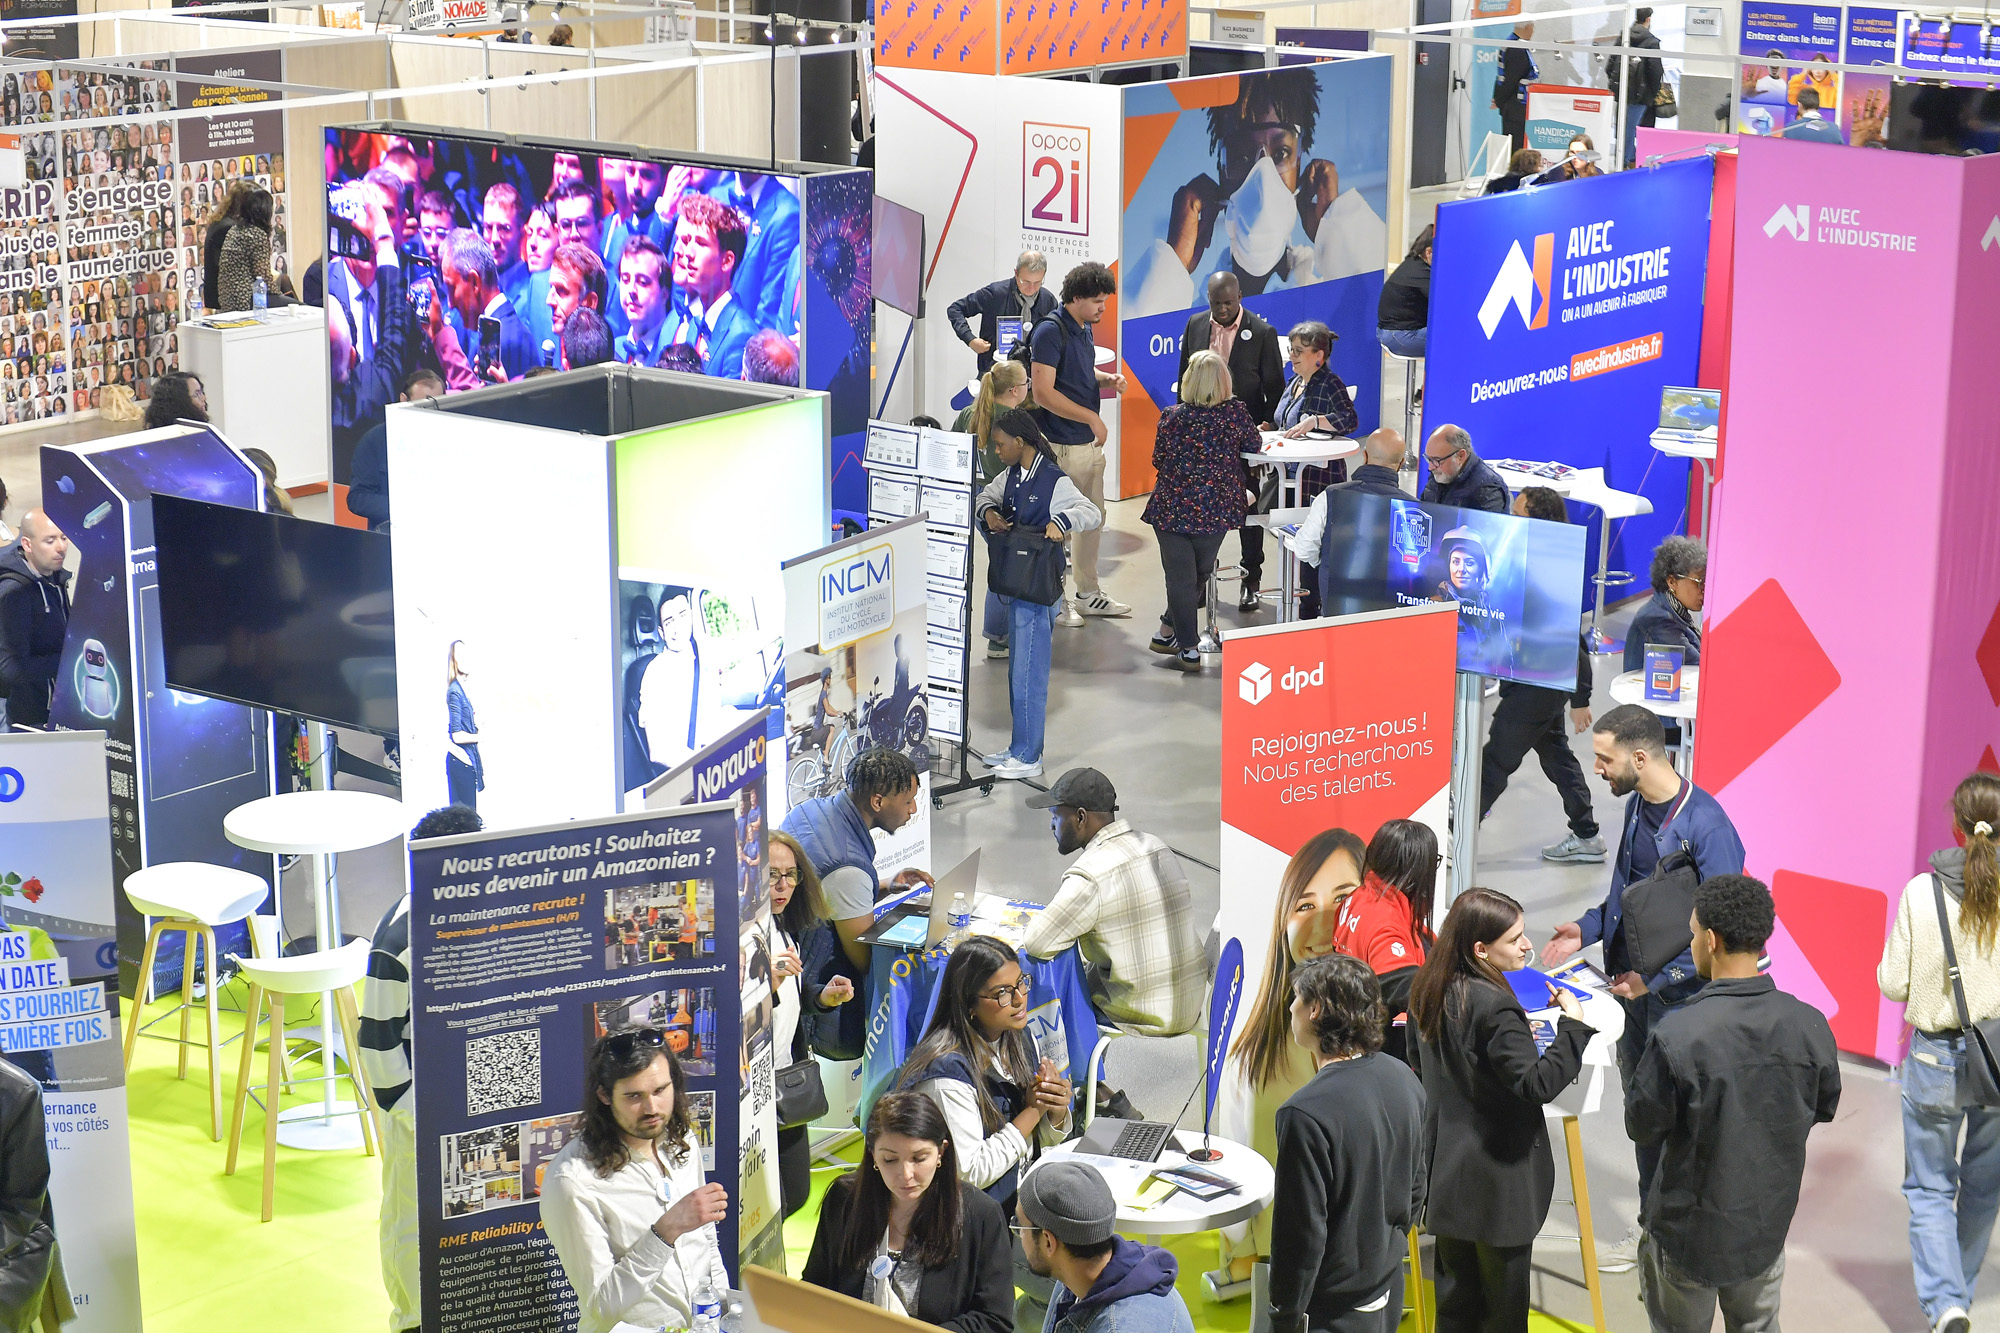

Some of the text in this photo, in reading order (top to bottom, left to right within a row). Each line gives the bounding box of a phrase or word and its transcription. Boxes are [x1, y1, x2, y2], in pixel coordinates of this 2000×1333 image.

[443, 1, 488, 20] NOMADE
[1692, 18, 1715, 26] SORTIE
[1757, 20, 1799, 29] MÉDICAMENT
[1746, 30, 1836, 46] Entrez dans le futur
[1851, 36, 1884, 48] Entrez
[1906, 50, 1978, 66] Entrez dans le
[214, 67, 246, 78] Ateliers
[192, 98, 208, 107] des
[199, 85, 239, 97] Échangez
[208, 119, 253, 131] Les 9 et 10 avril
[208, 131, 213, 139] à
[1533, 125, 1577, 138] HANDICAP
[208, 137, 254, 148] sur notre stand
[1031, 133, 1082, 151] opco
[1537, 135, 1546, 143] ET
[67, 181, 172, 212] s'engage
[1031, 156, 1080, 224] 2i
[1819, 206, 1860, 226] AVEC
[33, 232, 57, 250] de
[1021, 233, 1090, 247] COMPÉTENCES
[1021, 243, 1090, 257] INDUSTRIES
[1566, 219, 1615, 260] AVEC
[1817, 226, 1917, 252] L'INDUSTRIE
[0, 249, 175, 289] ans le numérique
[1562, 246, 1671, 301] L'INDUSTRIE
[1561, 285, 1668, 323] ON A UN AVENIR À FABRIQUER
[1150, 333, 1174, 357] On
[1470, 336, 1662, 404] Découvrez-nous aveclindustrie.fr
[822, 552, 890, 604] INCM
[827, 592, 887, 619] INSTITUT NATIONAL
[840, 606, 872, 624] DU CYCLE
[1462, 605, 1506, 620] votre vie
[828, 612, 886, 639] ET DU MOTOCYCLE
[1280, 661, 1324, 695] dpd
[104, 737, 132, 752] gistique
[1251, 711, 1428, 758] Rejoignez-nous !
[697, 735, 766, 803] Norauto
[1243, 738, 1433, 785] Nous recherchons
[1280, 770, 1397, 804] des talents.
[441, 826, 702, 877] Nous recrutons ! Souhaitez
[875, 859, 895, 871] métiers
[902, 851, 913, 861] deux
[913, 845, 925, 856] roues
[893, 838, 925, 859] des formations
[432, 847, 716, 901] vous devenir un Amazonien ?
[429, 893, 586, 926] La maintenance recrute !
[435, 911, 580, 940] Superviseur de maintenance (H/F)
[11, 962, 63, 989] DATE,
[15, 986, 101, 1019] POURRIEZ
[446, 1019, 465, 1027] Vous
[464, 1015, 489, 1026] pouvez
[488, 1011, 508, 1021] copier
[516, 1007, 530, 1015] lien
[529, 1004, 559, 1014] ci-dessus
[476, 1021, 501, 1031] scanner
[508, 1016, 525, 1026] code
[525, 1015, 537, 1023] QR
[1210, 964, 1241, 1073] Norauto
[65, 1017, 107, 1045] FOIS.
[44, 1102, 97, 1115] ernance
[52, 1116, 109, 1132] vos côtés
[744, 1147, 767, 1189] faire
[438, 1233, 469, 1248] RME
[470, 1221, 534, 1243] Reliability
[439, 1241, 526, 1266] Au coeur d'Amazon,
[439, 1249, 545, 1277] technologies de pointe
[439, 1264, 523, 1289] équipements et les
[440, 1268, 563, 1299] novation à chaque étape du
[440, 1279, 570, 1311] de la qualité durable et l'état
[440, 1293, 558, 1323] chaque site Amazon, cette
[461, 1313, 515, 1331] d'innovation
[496, 1316, 562, 1333] processus plus
[547, 1325, 564, 1333] leur
